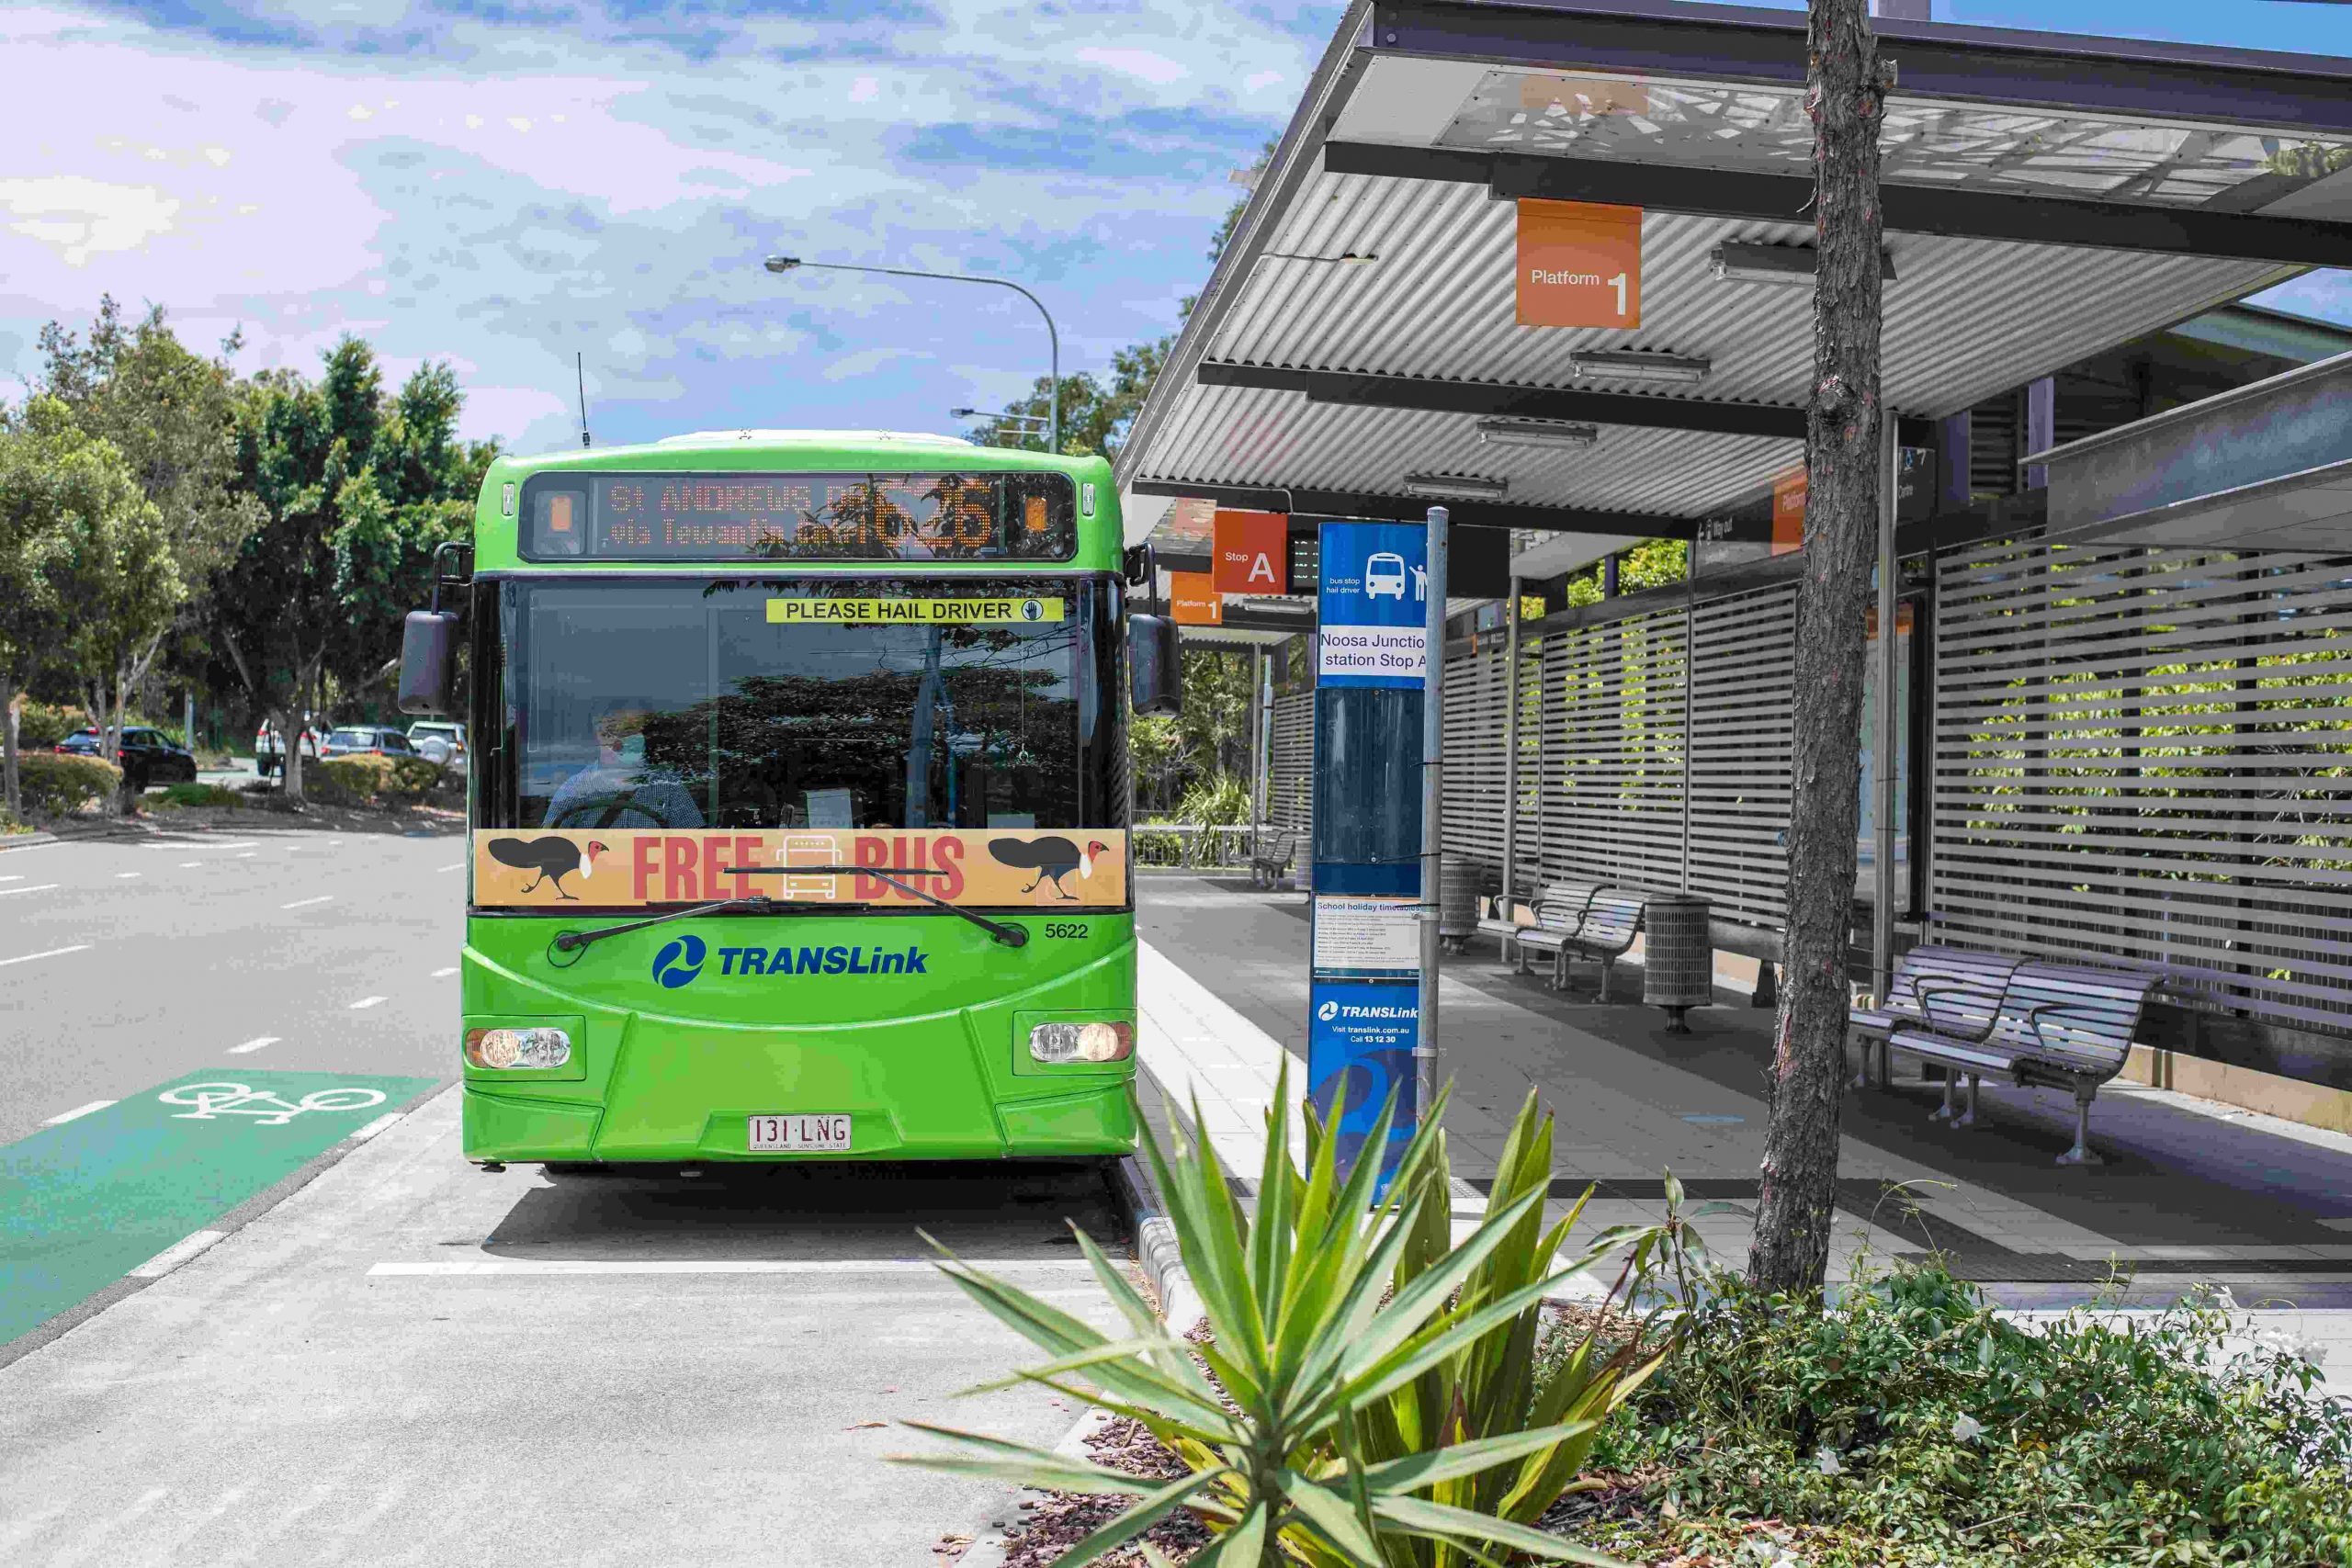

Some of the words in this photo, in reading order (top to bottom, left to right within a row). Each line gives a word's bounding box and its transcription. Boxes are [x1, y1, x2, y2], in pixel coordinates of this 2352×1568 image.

[1531, 269, 1600, 286] Platform
[1608, 272, 1626, 316] 1
[611, 486, 644, 511] St
[661, 486, 811, 511] ANDREWS
[876, 478, 990, 547] 626
[611, 518, 651, 545] via
[1225, 552, 1249, 562] Stop
[1248, 552, 1275, 583] A
[1344, 578, 1360, 586] stop
[786, 603, 871, 619] PLEASE
[877, 603, 926, 619] HAIL
[933, 603, 1012, 618] DRIVER
[1176, 599, 1206, 607] Platform
[1207, 601, 1217, 619] 1
[1320, 633, 1367, 647] Noosa
[1372, 634, 1425, 649] Junctio
[1325, 652, 1375, 666] station
[1380, 653, 1414, 671] Stop
[633, 836, 763, 899] FREE
[854, 835, 965, 900] BUS
[1317, 902, 1345, 910] School
[1347, 902, 1377, 912] holiday
[1044, 923, 1089, 939] 5622
[718, 945, 930, 976] TRANSLink
[1341, 1006, 1419, 1019] TRANSLink
[1348, 1026, 1409, 1034] translink.com.au
